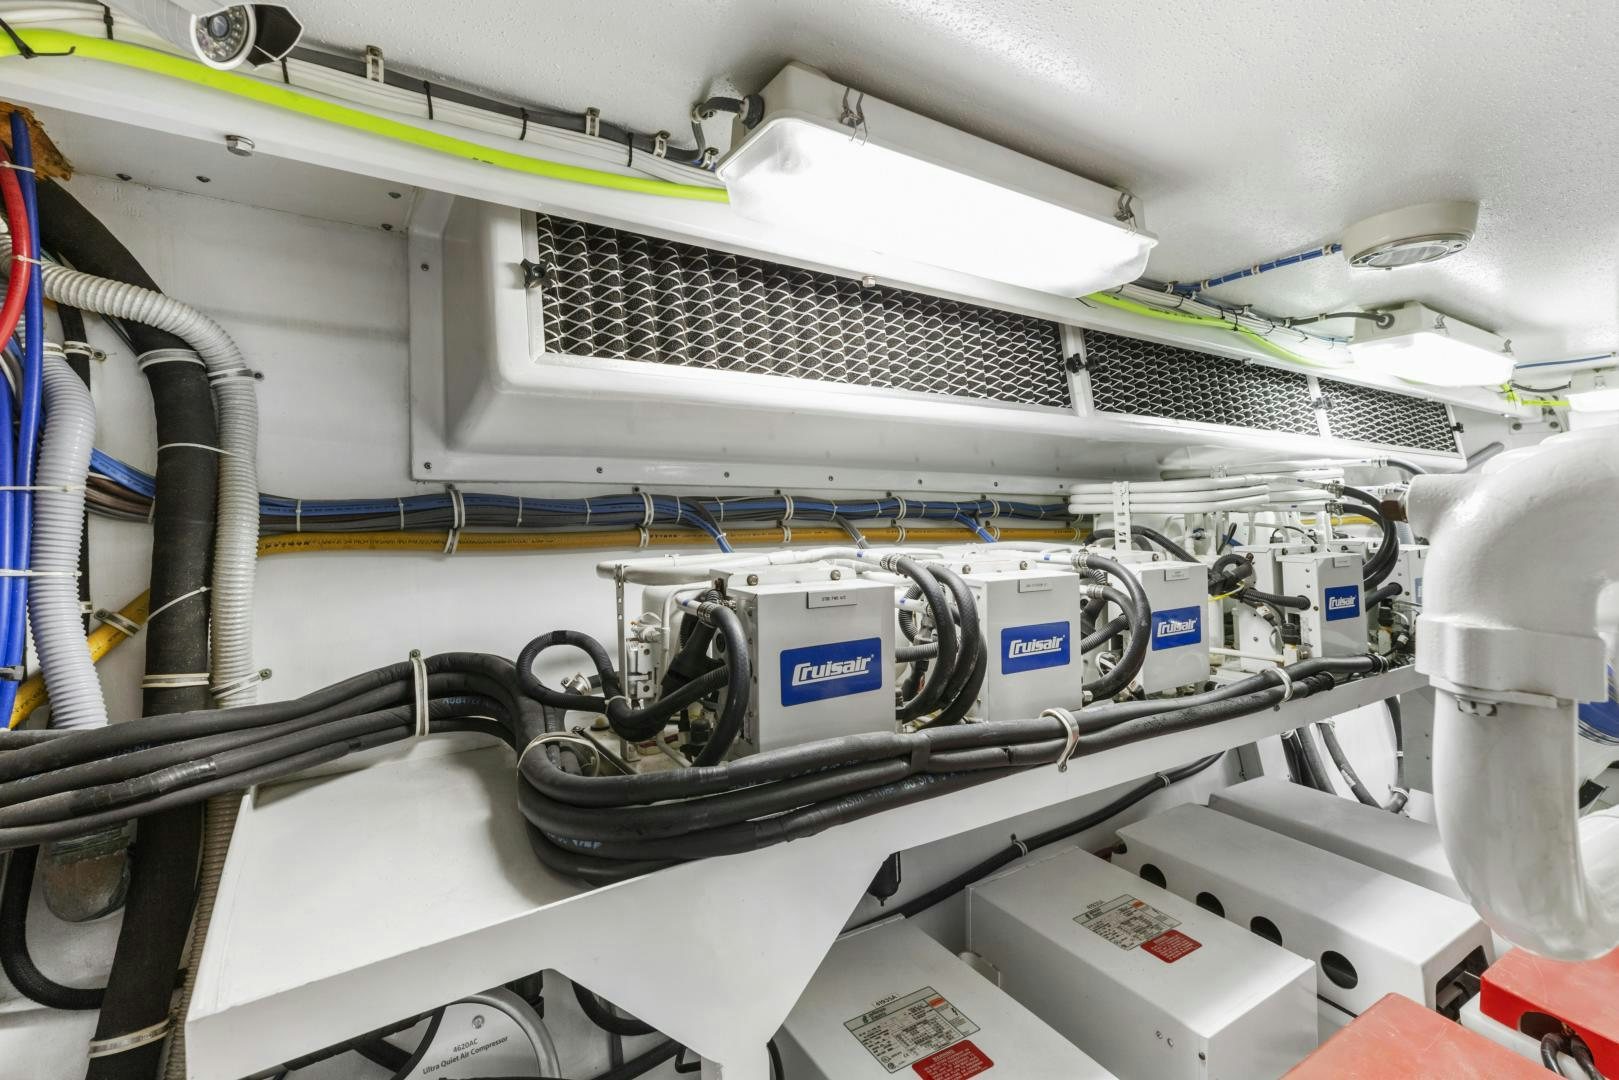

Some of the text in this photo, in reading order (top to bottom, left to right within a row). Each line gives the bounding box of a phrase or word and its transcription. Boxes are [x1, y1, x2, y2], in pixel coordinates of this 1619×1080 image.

[1329, 595, 1356, 610] Cruisair
[1157, 618, 1197, 637] Cruisair
[1009, 635, 1065, 659] Cruisair
[792, 655, 872, 686] Cruisair
[422, 1036, 508, 1075] Ultra Quiet Air Compressor
[453, 1038, 479, 1053] 4620AC
